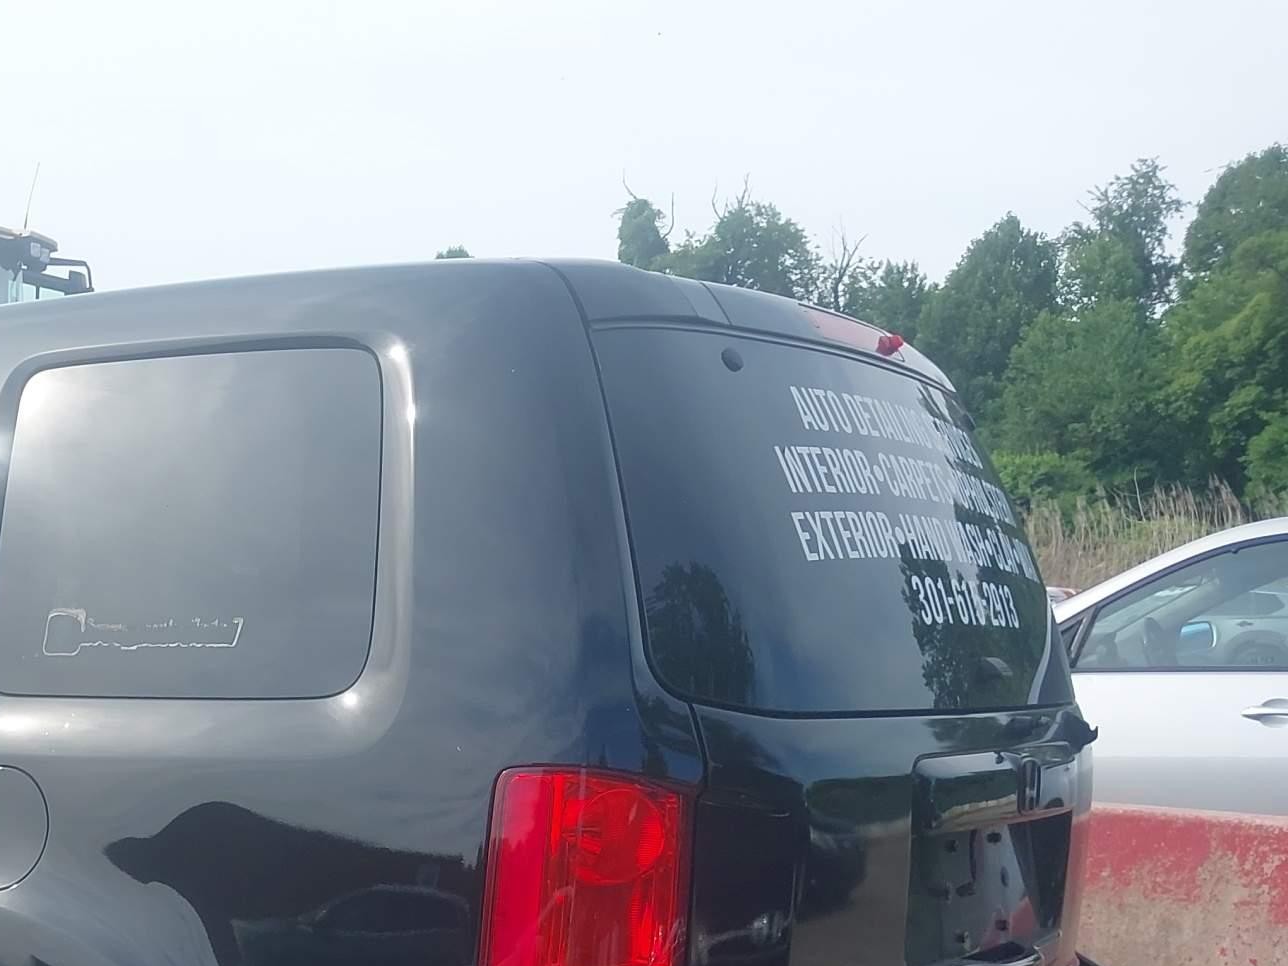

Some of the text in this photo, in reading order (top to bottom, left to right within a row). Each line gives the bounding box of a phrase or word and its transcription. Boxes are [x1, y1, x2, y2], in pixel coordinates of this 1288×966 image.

[790, 386, 853, 434] AUTO
[842, 393, 933, 449] DETAILING
[774, 446, 881, 494] INTERIOR
[879, 452, 954, 504] CARPETS
[791, 511, 902, 561] EXTERIOR
[899, 513, 952, 561] HAND
[944, 519, 992, 567] WASH
